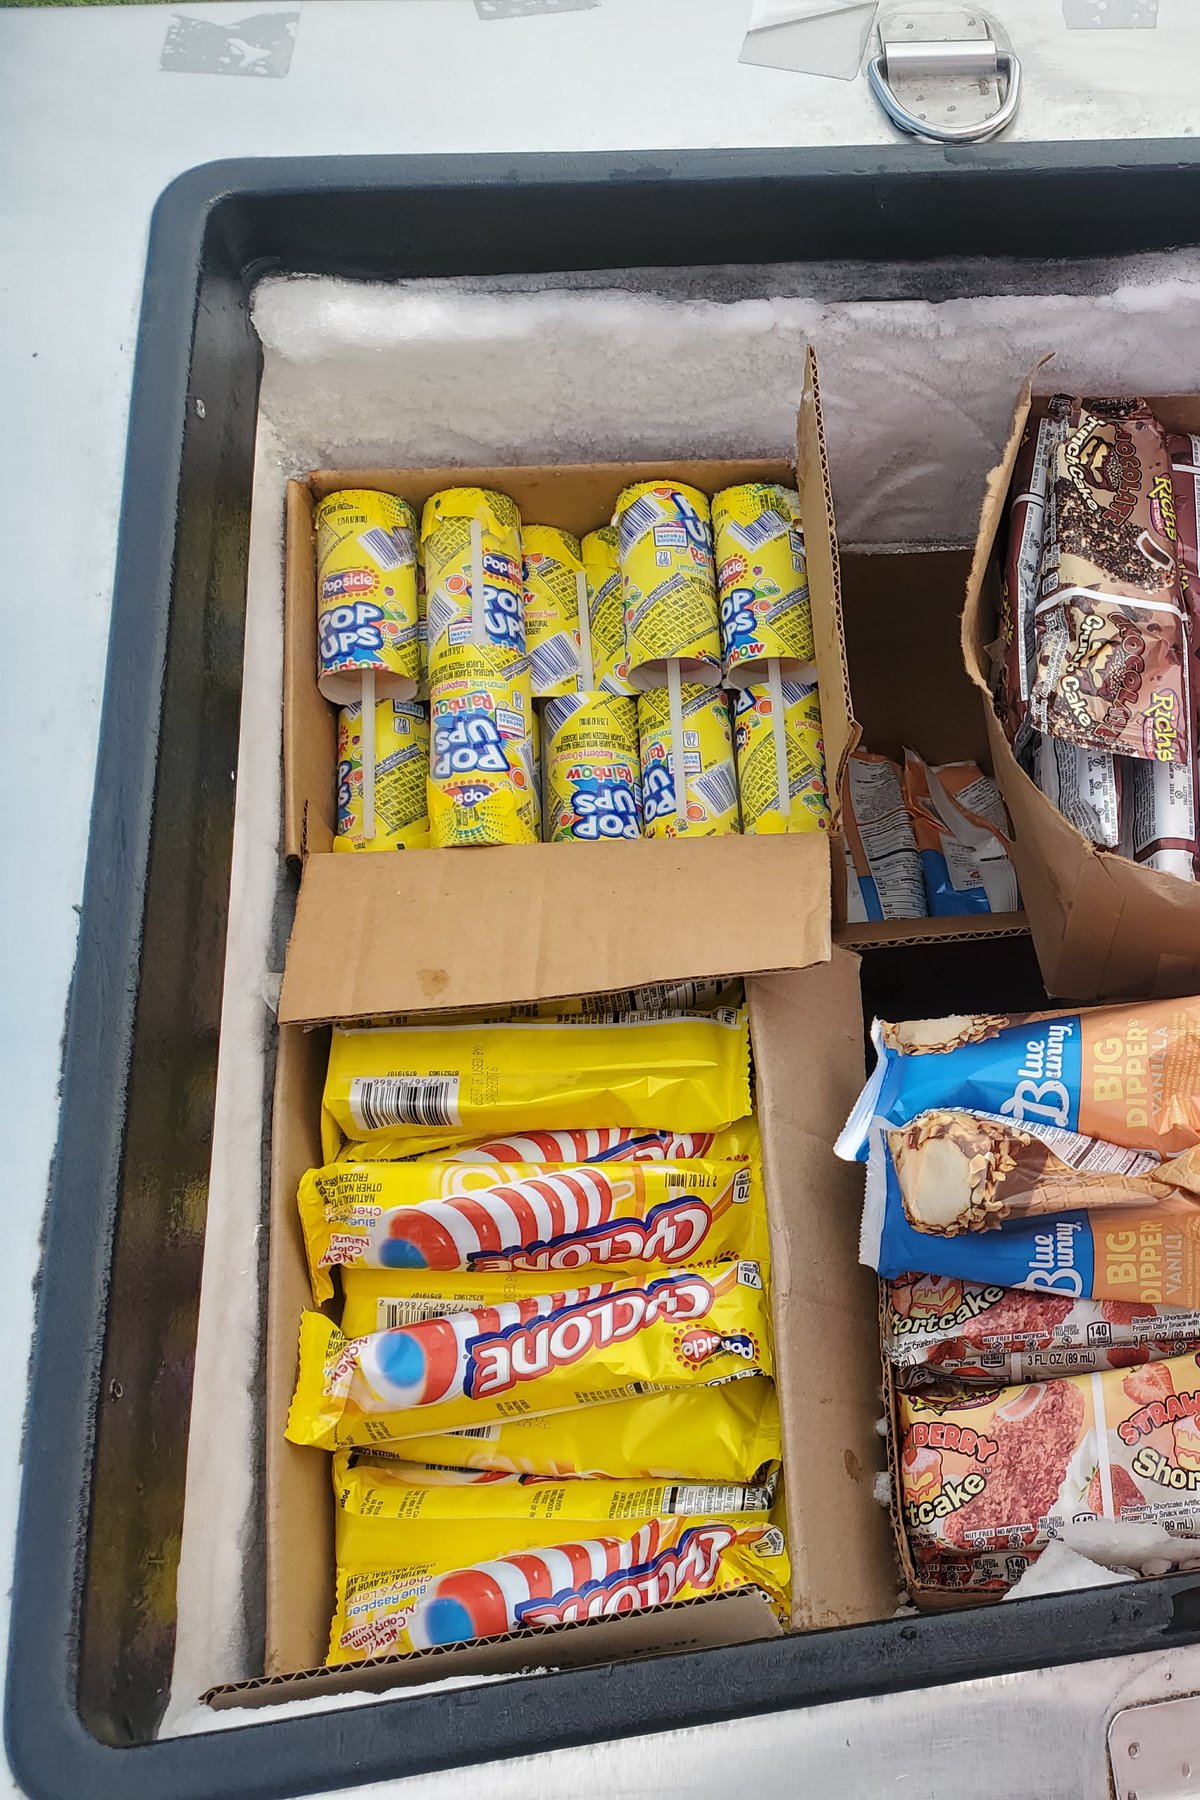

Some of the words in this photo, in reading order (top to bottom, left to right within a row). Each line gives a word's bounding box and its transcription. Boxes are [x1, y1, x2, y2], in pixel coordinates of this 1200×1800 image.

[1068, 465, 1099, 511] Cake
[1148, 475, 1177, 541] Rich's
[323, 572, 374, 592] Popsicle
[319, 604, 380, 638] POP
[321, 628, 380, 659] UPS
[1061, 675, 1093, 727] Cake
[436, 719, 499, 751] UPS
[1142, 692, 1178, 762] Rich's
[435, 742, 507, 777] POP
[566, 766, 634, 784] Rainbow
[575, 790, 636, 815] UPS
[576, 815, 642, 839] POP
[1093, 1038, 1124, 1101] BIG
[1151, 1026, 1169, 1117] VANILLA
[373, 1078, 404, 1087] 57866
[408, 1078, 440, 1087] 77567
[1067, 1147, 1083, 1164] Protein
[339, 1173, 369, 1184] FROZEN
[664, 1172, 688, 1188] (80mL)
[688, 1174, 698, 1188] OZ
[357, 1183, 382, 1194] OTHER
[1105, 1231, 1138, 1285] BIG
[1140, 1220, 1163, 1304] DIPPER
[1165, 1231, 1185, 1297] VANILL
[743, 1273, 758, 1286] 70
[398, 1301, 430, 1310] 57866
[892, 1288, 1005, 1335] ortcake
[1132, 1316, 1163, 1326] Strawberry
[1164, 1313, 1193, 1323] Shortcake
[1132, 1324, 1152, 1332] Frozen
[1152, 1322, 1168, 1331] Dairy
[1169, 1320, 1187, 1329] Snack
[1188, 1319, 1200, 1328] with
[478, 1285, 711, 1393] CYCLONE
[1090, 1325, 1107, 1337] 140
[681, 1336, 753, 1360] Popsicle
[1028, 1355, 1033, 1366] 3
[1049, 1353, 1063, 1365] OZ
[1065, 1352, 1078, 1366] (89
[1079, 1351, 1096, 1366] mL)
[1120, 1504, 1152, 1516] Strawberry
[1152, 1500, 1183, 1512] Shortcake
[1121, 1512, 1141, 1523] Frozen
[1141, 1510, 1158, 1522] Dairy
[1158, 1509, 1177, 1519] Snack
[1177, 1507, 1190, 1517] with
[978, 1530, 995, 1538] FREE
[1004, 1525, 1033, 1535] ARTIFICIAL
[1177, 1519, 1194, 1532] mL)
[754, 1540, 767, 1552] 70
[1009, 1558, 1026, 1569] 140
[372, 1567, 407, 1579] NATURAL
[391, 1570, 428, 1582] NATURAL
[358, 1577, 388, 1591] FLAVOR
[390, 1575, 432, 1592] Cherry
[401, 1585, 427, 1601] Blue
[347, 1593, 400, 1617] Raspber
[353, 1630, 376, 1648] from
